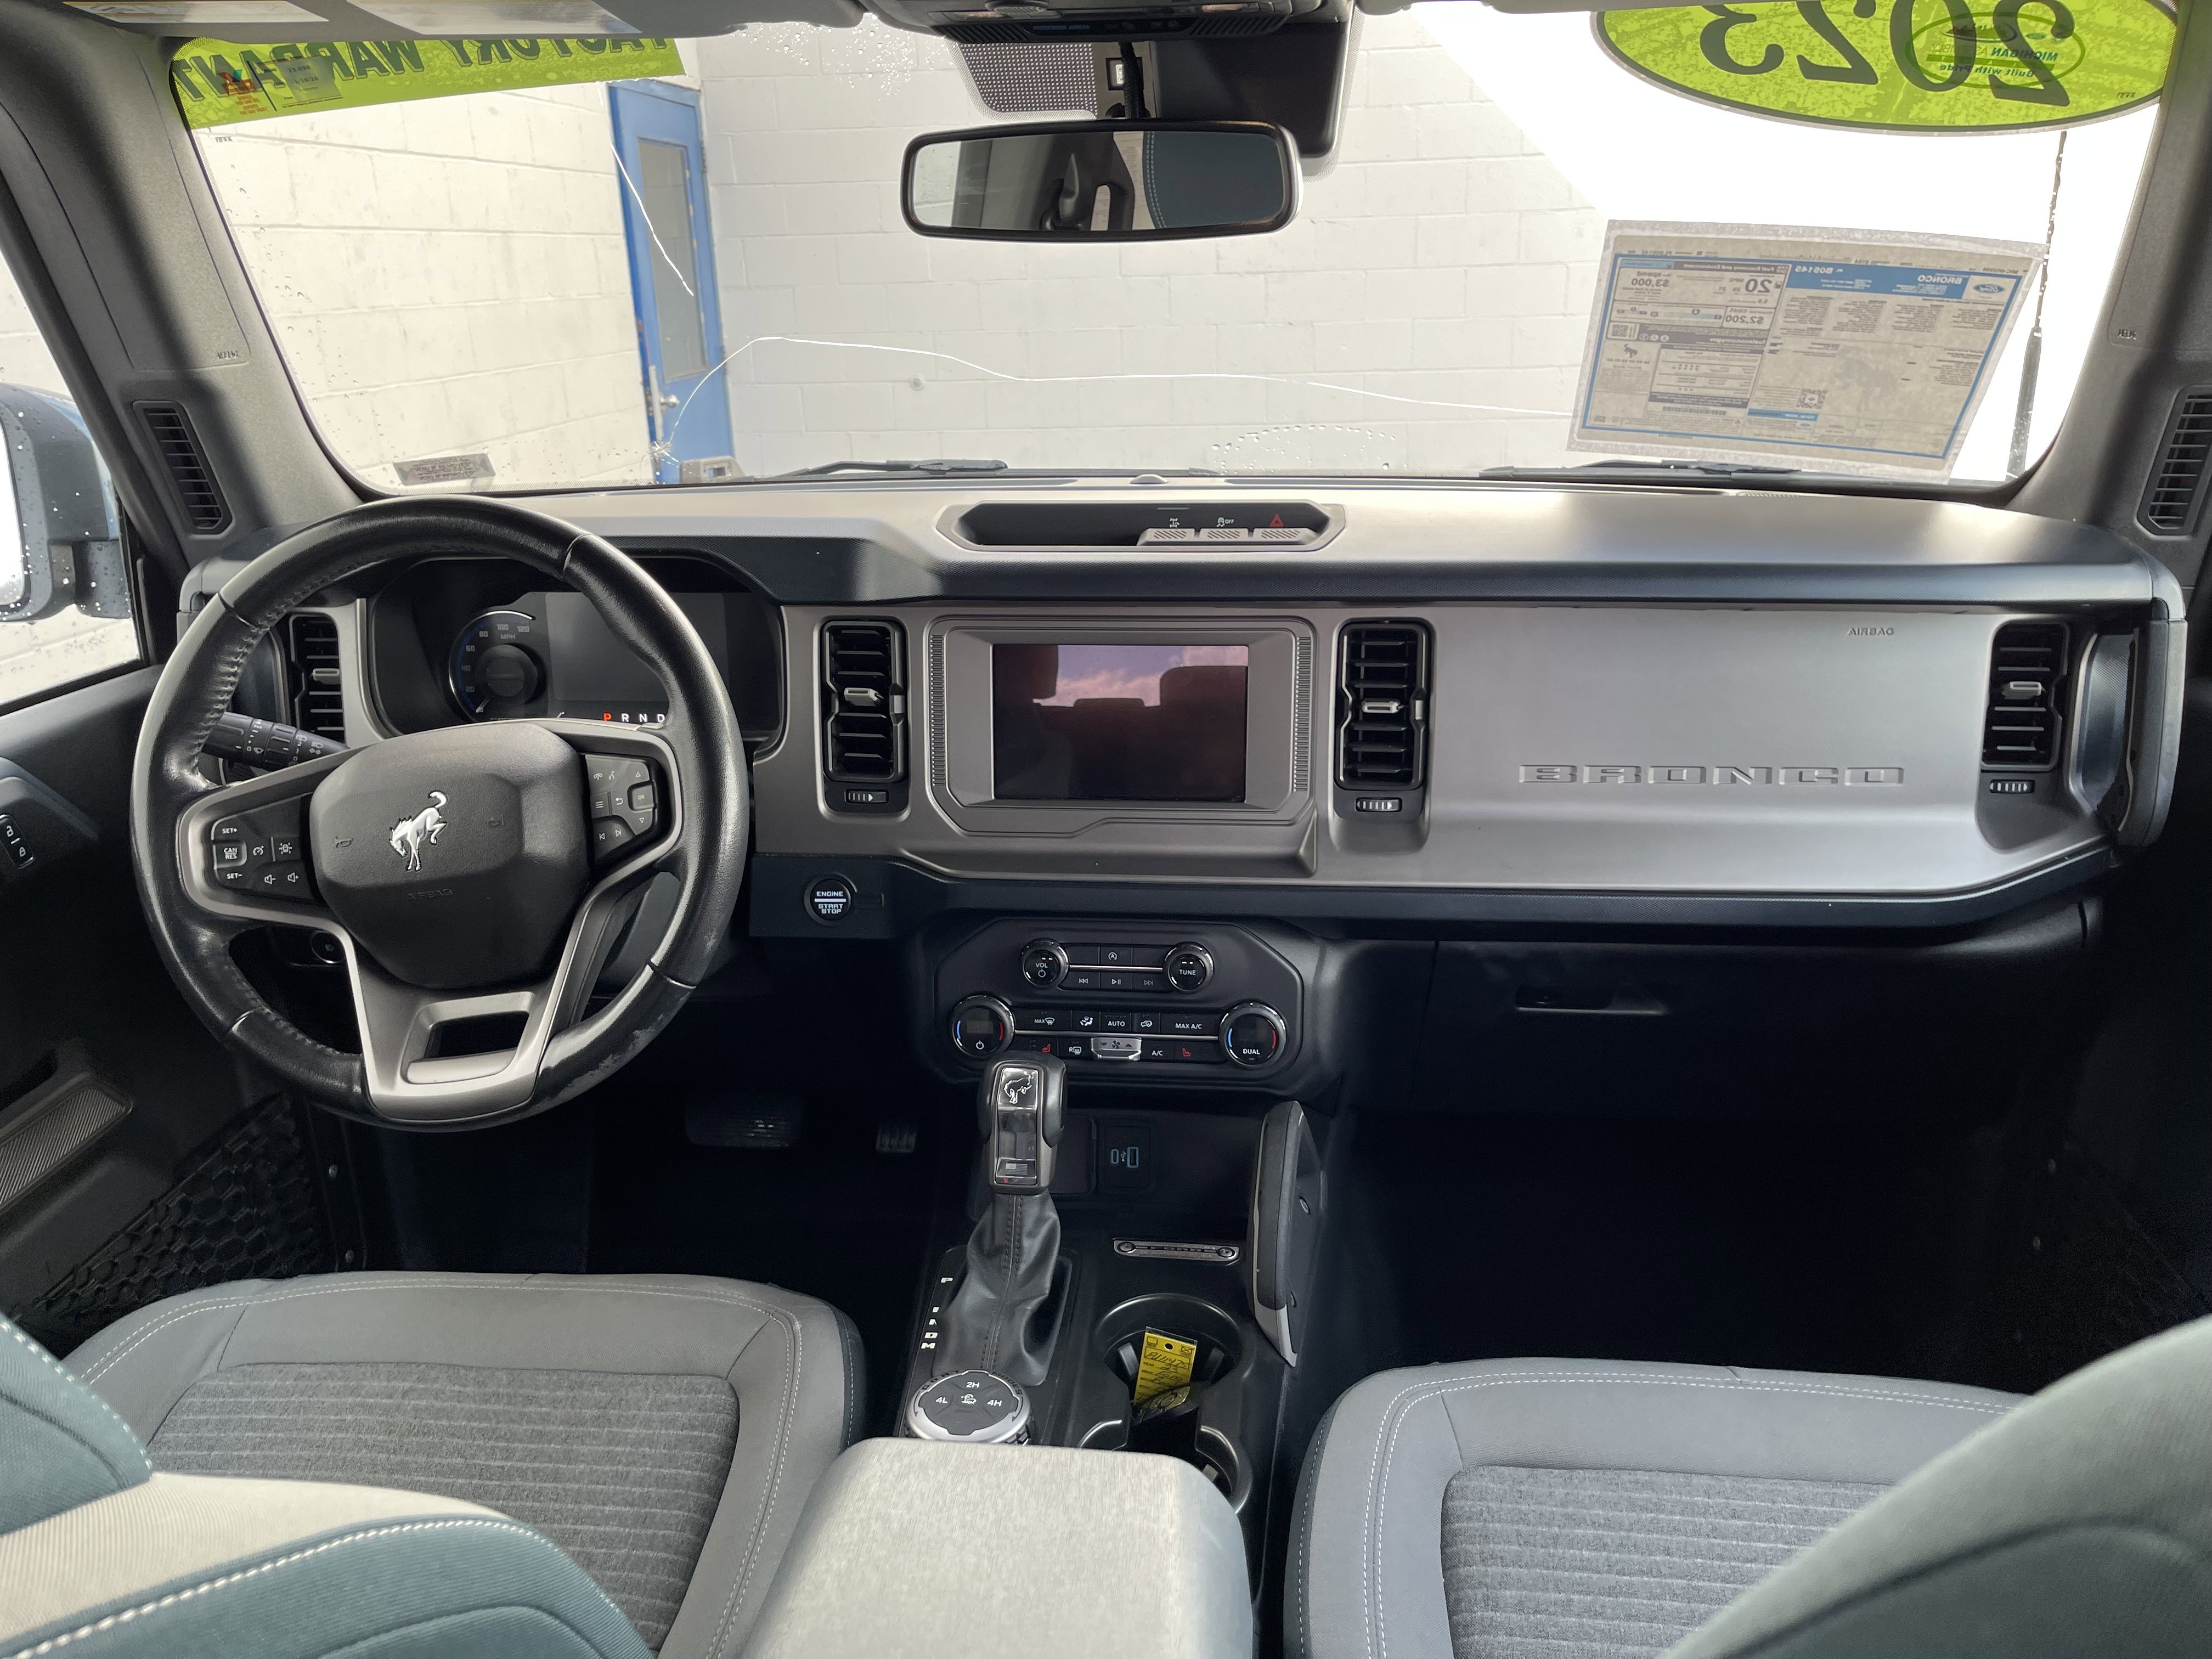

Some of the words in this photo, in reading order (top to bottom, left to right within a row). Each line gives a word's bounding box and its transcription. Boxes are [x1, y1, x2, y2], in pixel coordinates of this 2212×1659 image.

[496, 623, 510, 631] 100
[516, 625, 531, 633] 120
[1847, 627, 1895, 636] AIRBAG
[603, 713, 612, 722] P
[621, 713, 630, 723] R
[639, 714, 648, 723] N
[657, 714, 665, 723] D
[1519, 764, 1906, 787] BRONCO
[986, 1399, 1003, 1407] 4H
